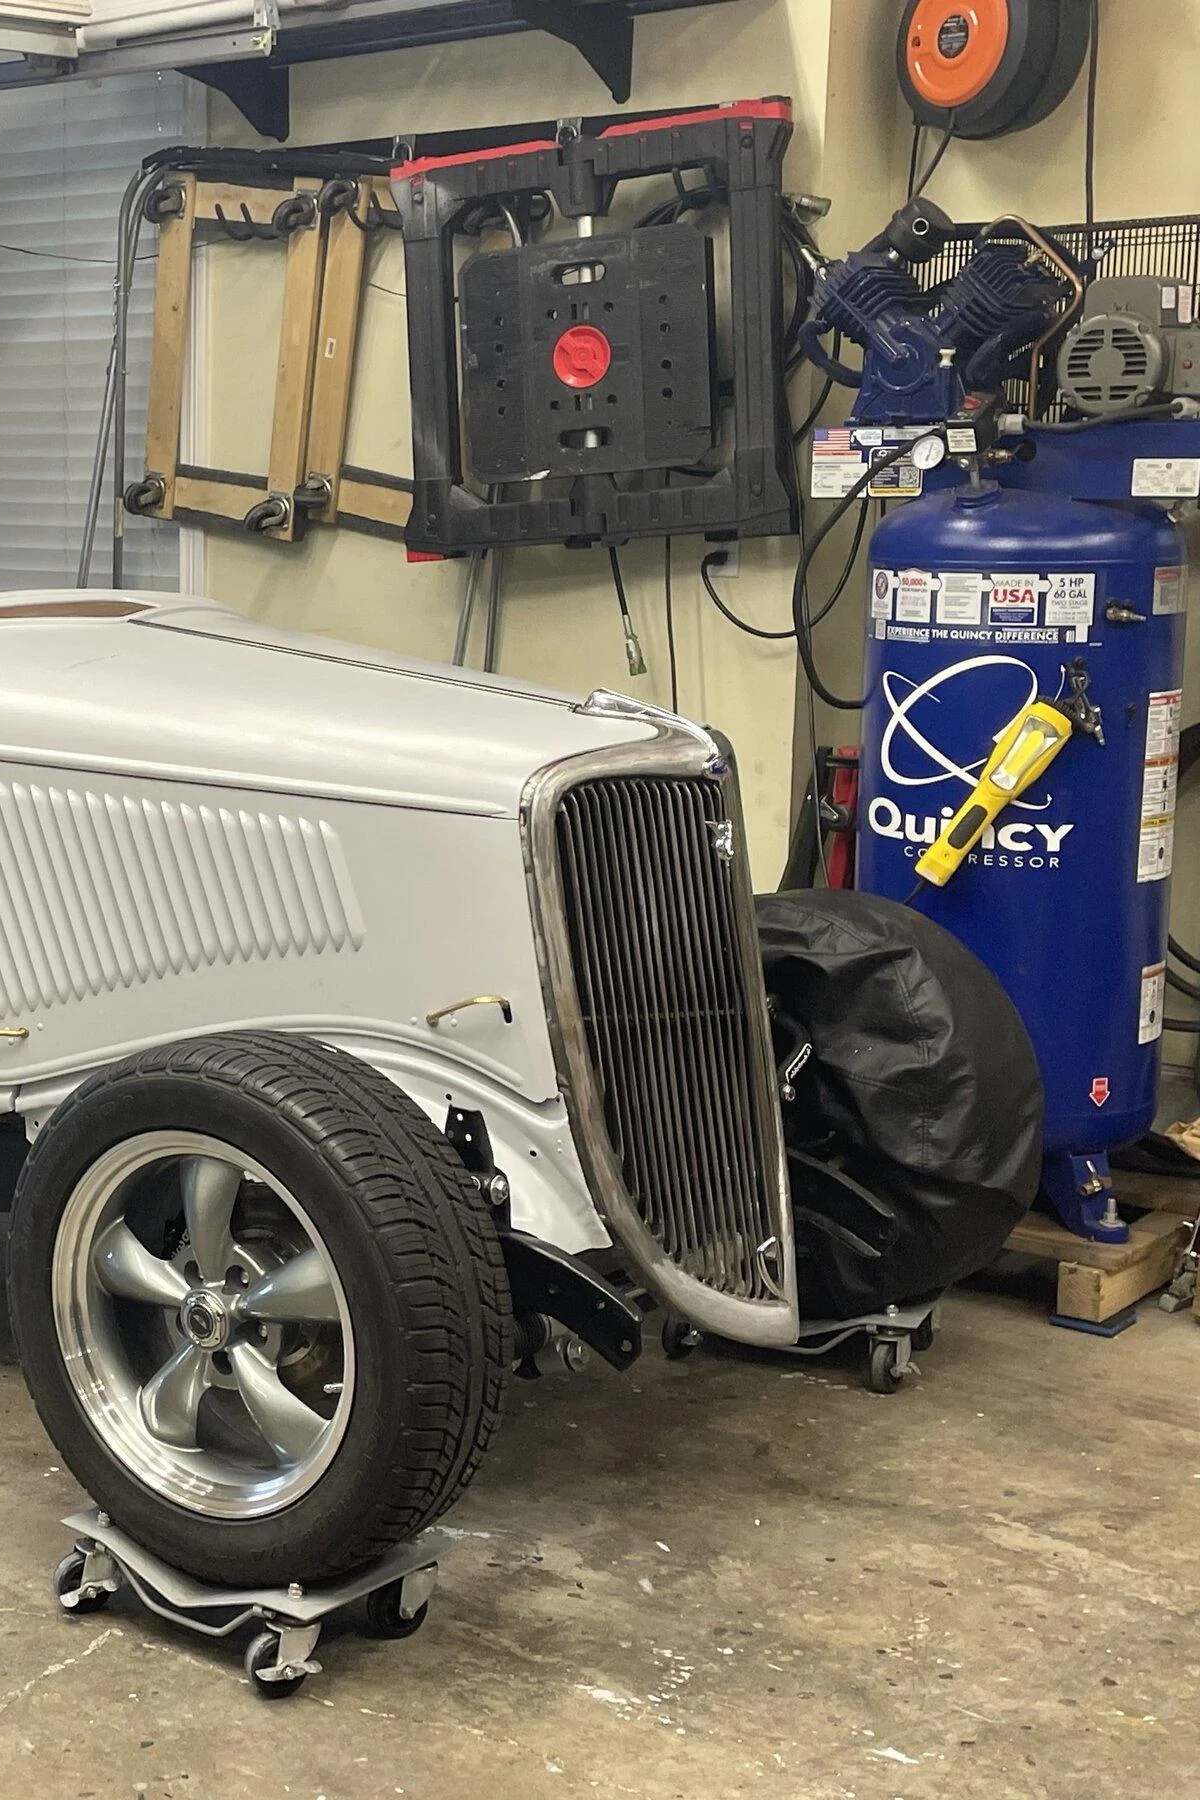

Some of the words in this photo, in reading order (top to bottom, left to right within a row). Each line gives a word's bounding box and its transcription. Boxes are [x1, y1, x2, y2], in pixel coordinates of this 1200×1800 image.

[1059, 578, 1065, 588] 5
[1070, 578, 1084, 588] HP
[993, 589, 1035, 603] USA
[1054, 590, 1066, 599] 60
[1069, 590, 1087, 599] GAL
[887, 626, 930, 637] EXPERIENCE
[932, 629, 948, 639] THE
[950, 630, 993, 640] QUINCY
[995, 631, 1059, 641] DIFFERENCE
[904, 845, 1060, 868] CORESSOR
